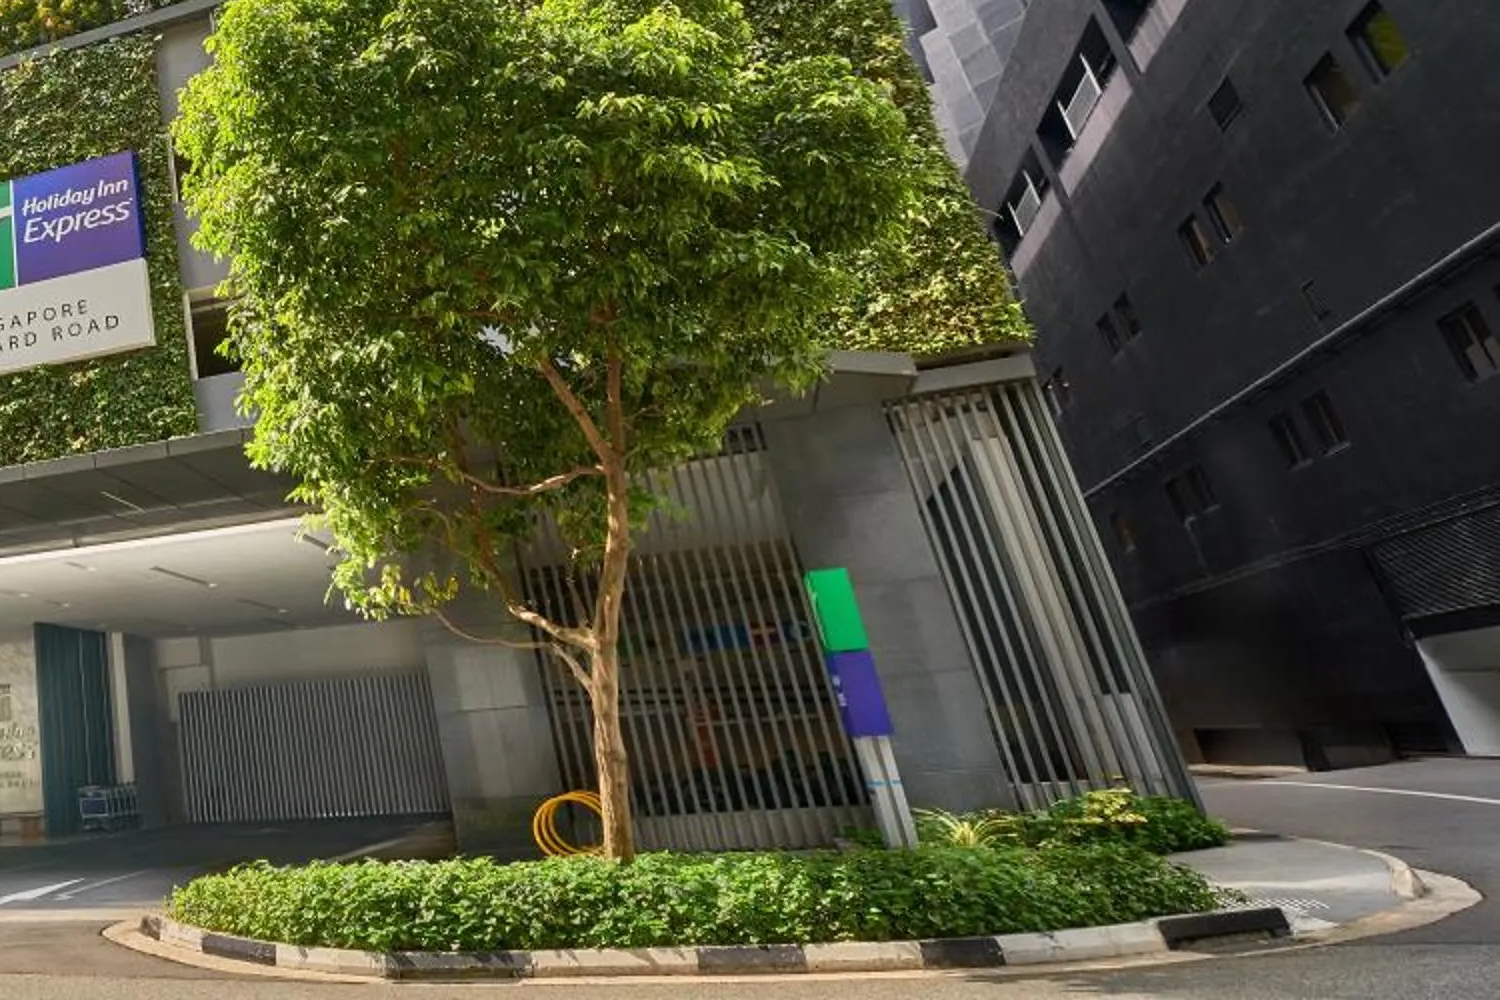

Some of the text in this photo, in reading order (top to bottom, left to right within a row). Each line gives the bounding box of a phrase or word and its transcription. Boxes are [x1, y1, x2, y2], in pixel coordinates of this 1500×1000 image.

[22, 179, 129, 216] Holiday Inn
[22, 200, 132, 244] Express
[52, 314, 120, 341] ROAD
